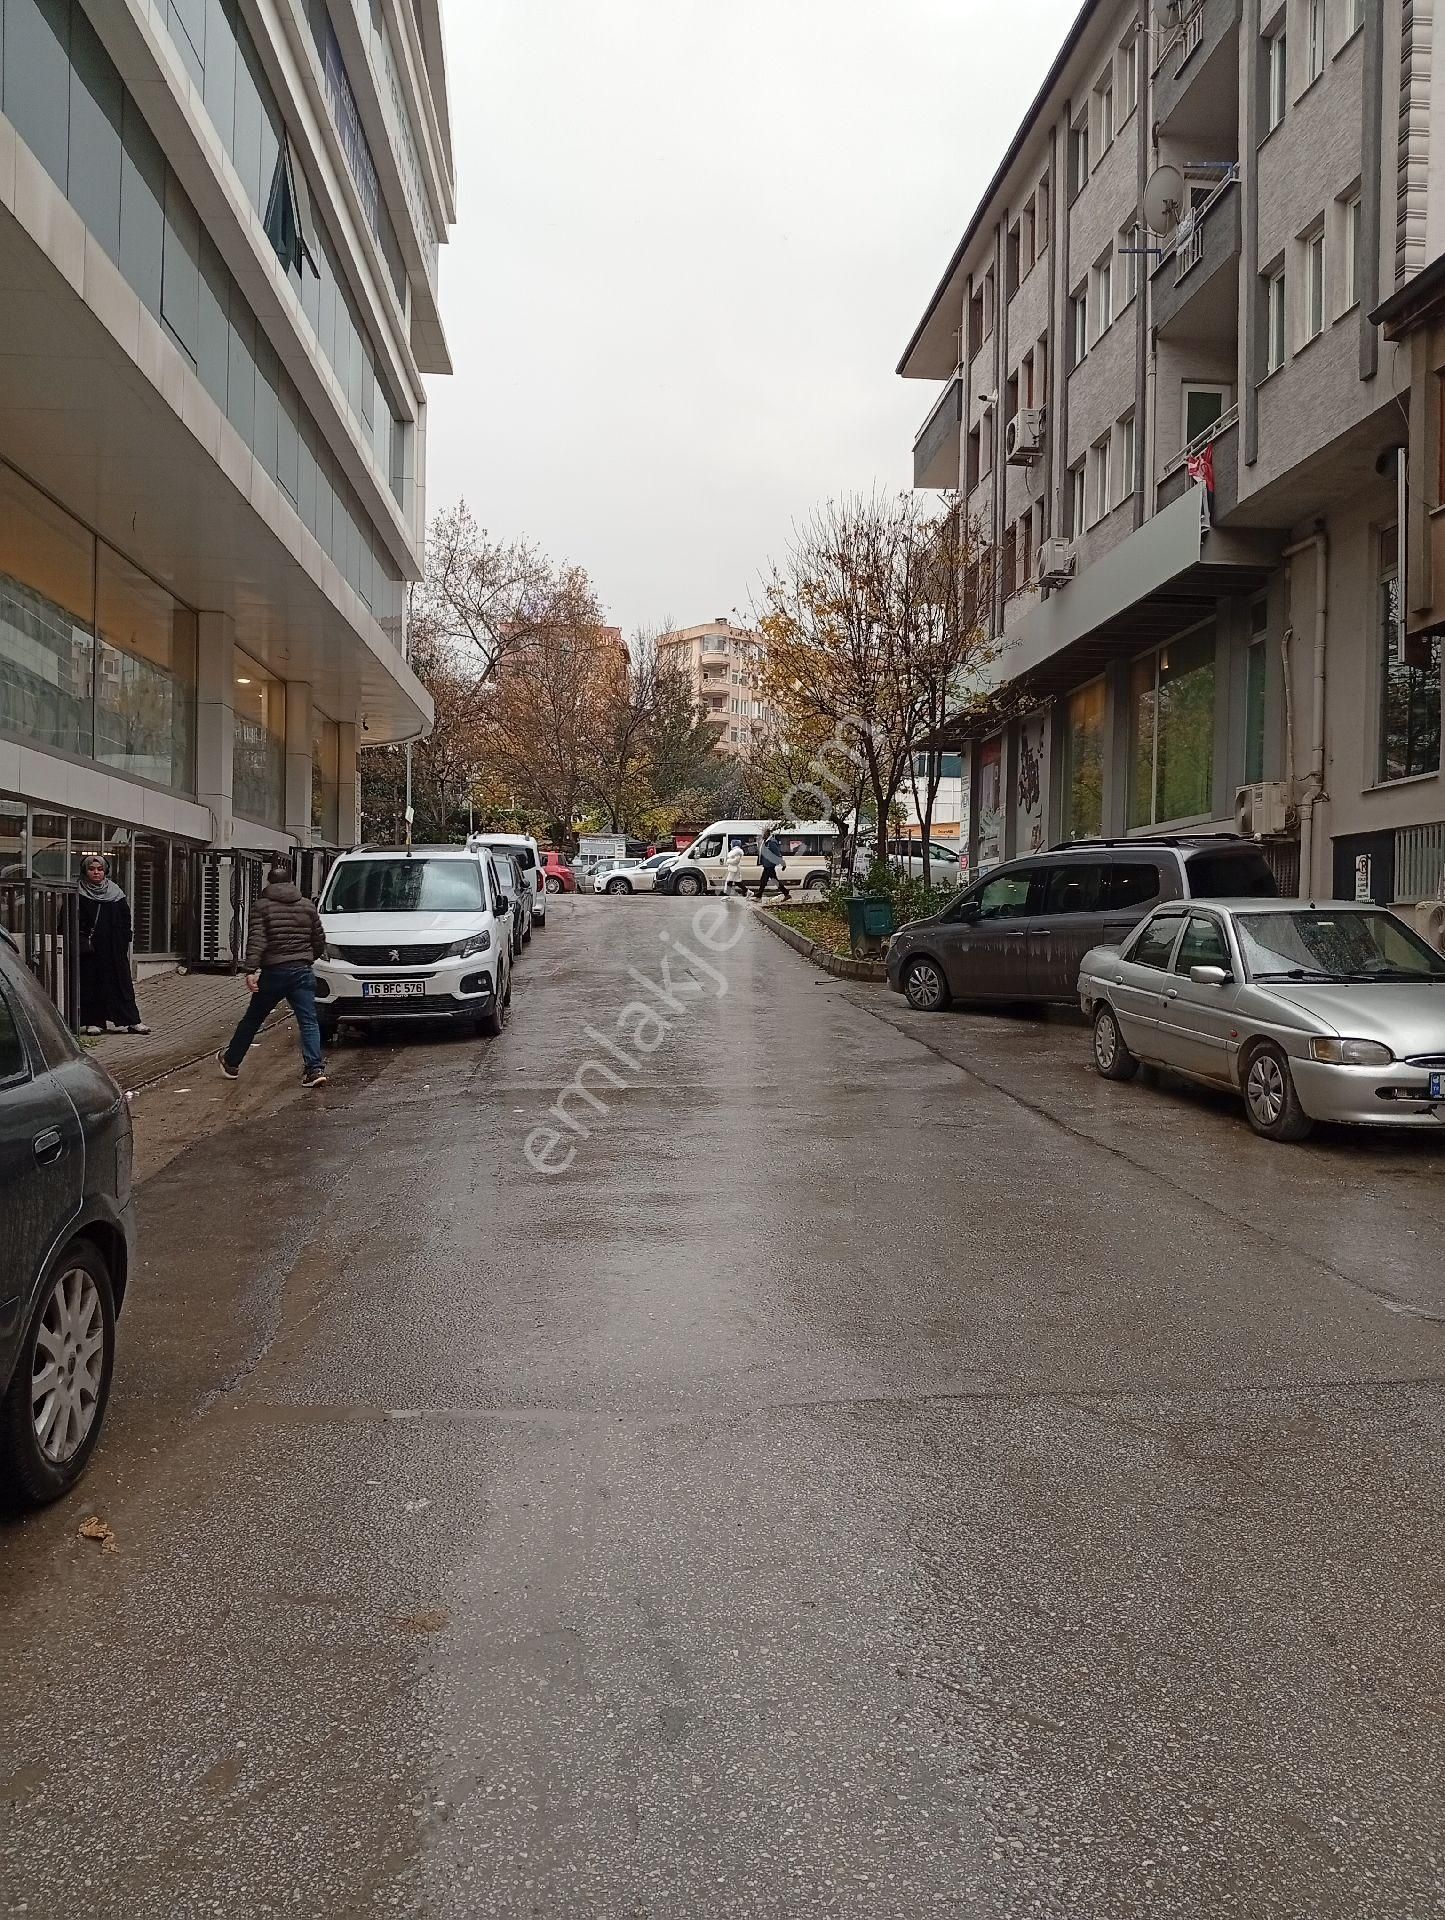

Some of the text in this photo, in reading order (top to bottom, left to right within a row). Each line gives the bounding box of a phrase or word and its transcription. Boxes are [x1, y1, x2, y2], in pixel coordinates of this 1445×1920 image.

[370, 983, 422, 994] 16 BFC 576
